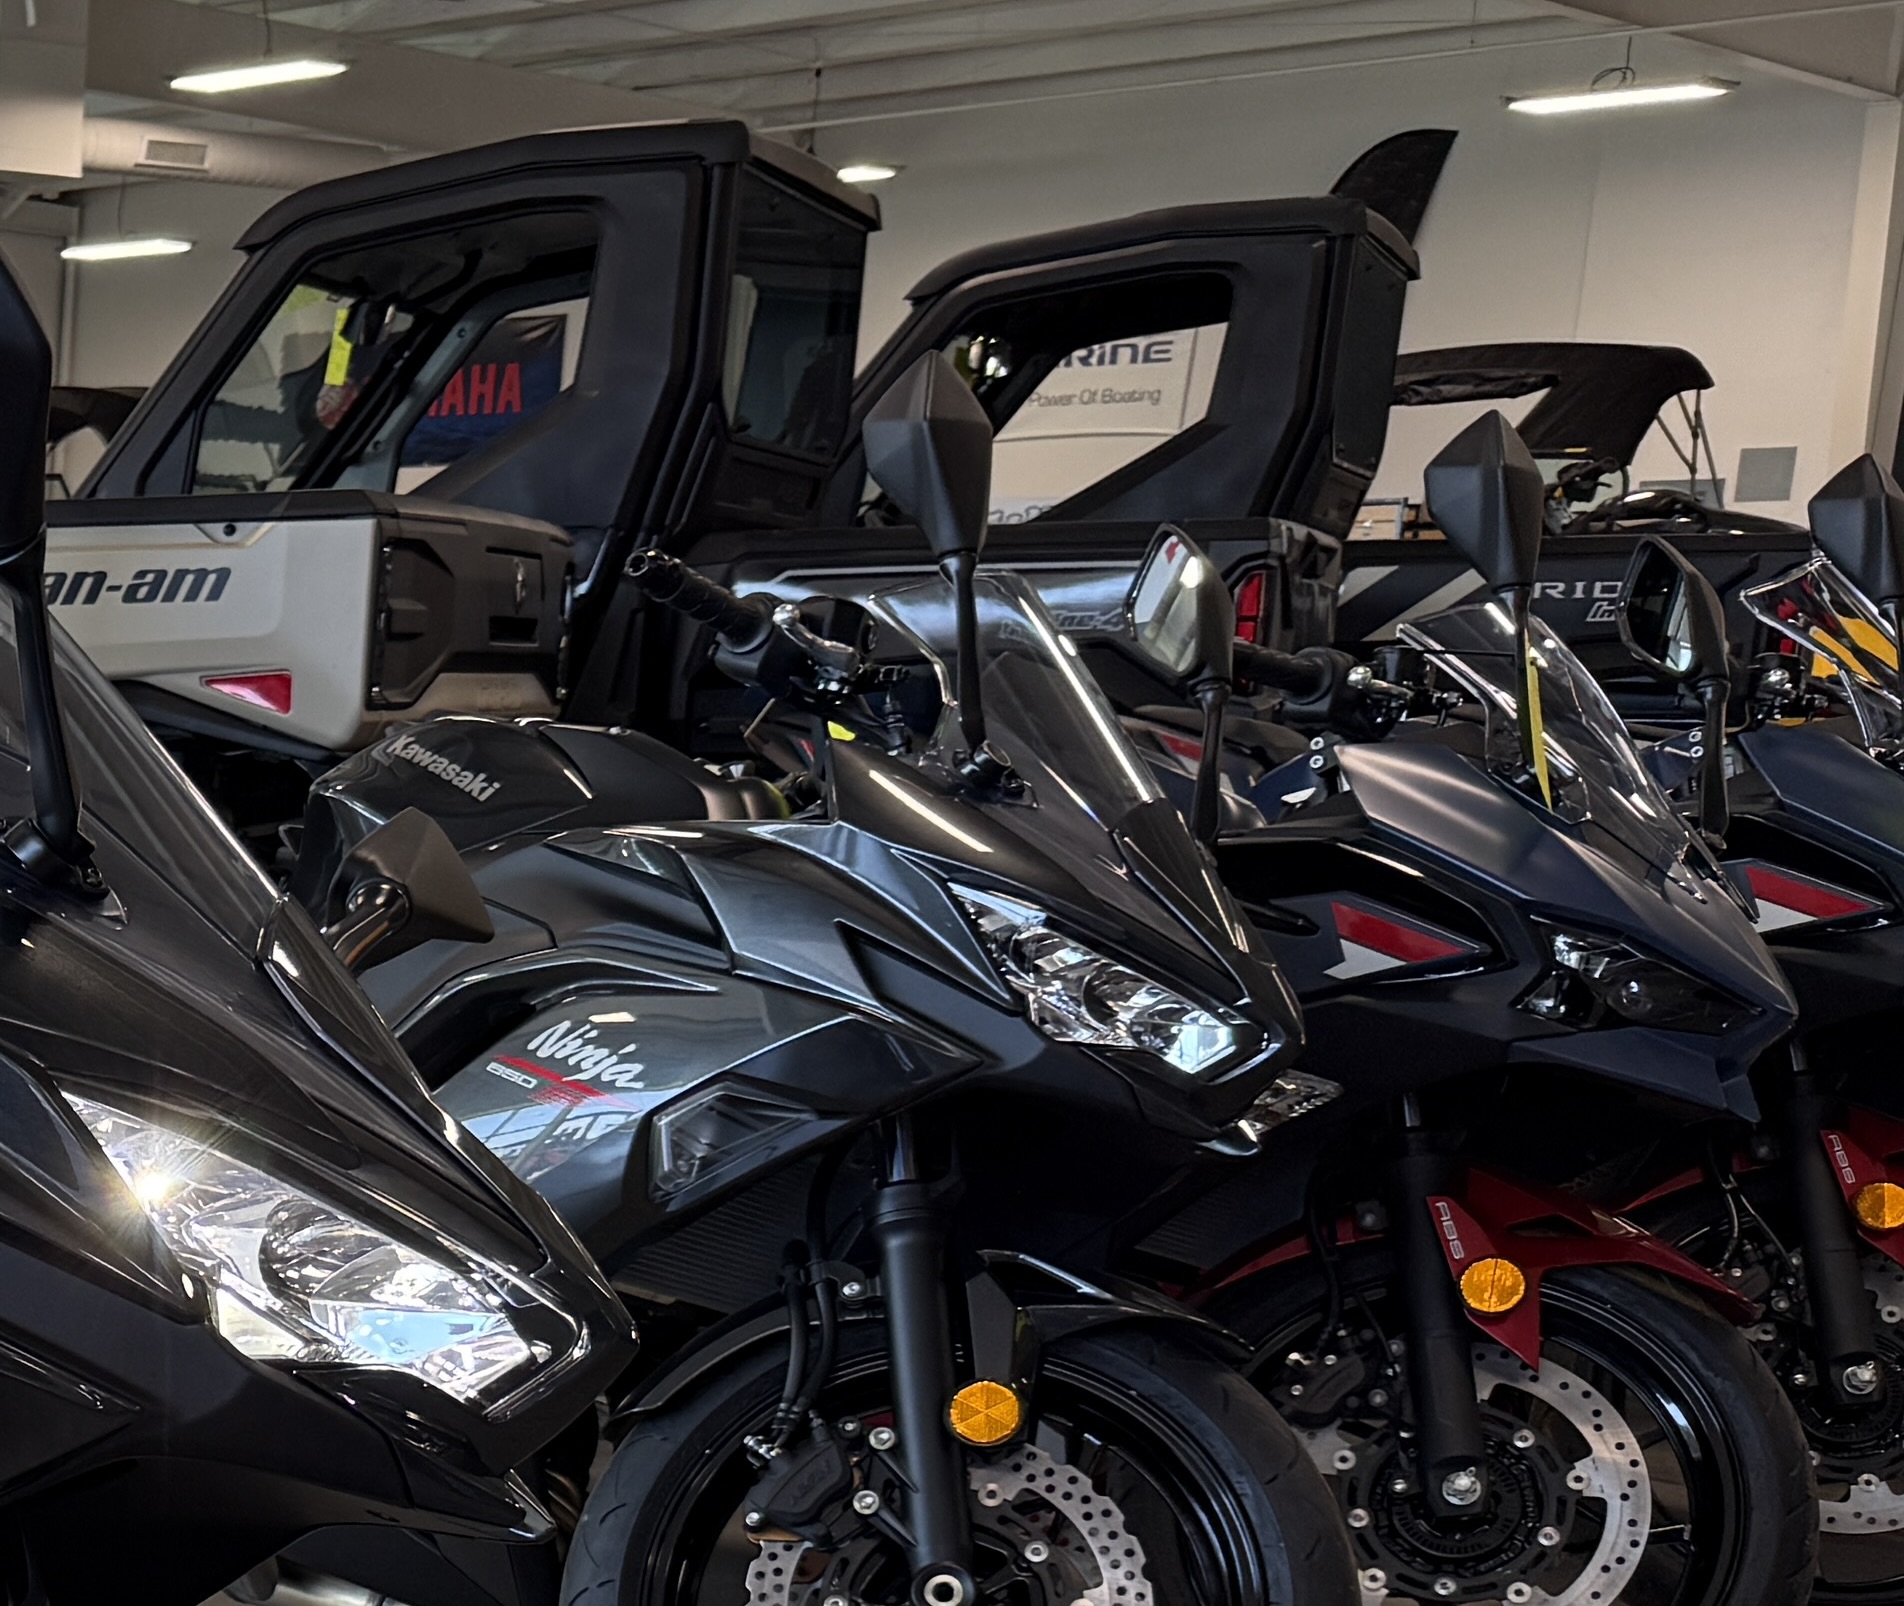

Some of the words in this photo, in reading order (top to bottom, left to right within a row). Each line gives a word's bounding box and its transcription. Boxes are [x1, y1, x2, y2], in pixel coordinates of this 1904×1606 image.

[44, 567, 232, 605] an-am
[385, 734, 502, 802] Kawasaki
[486, 1062, 538, 1089] 650
[527, 1020, 645, 1089] Ninja
[1434, 1201, 1465, 1259] ABS
